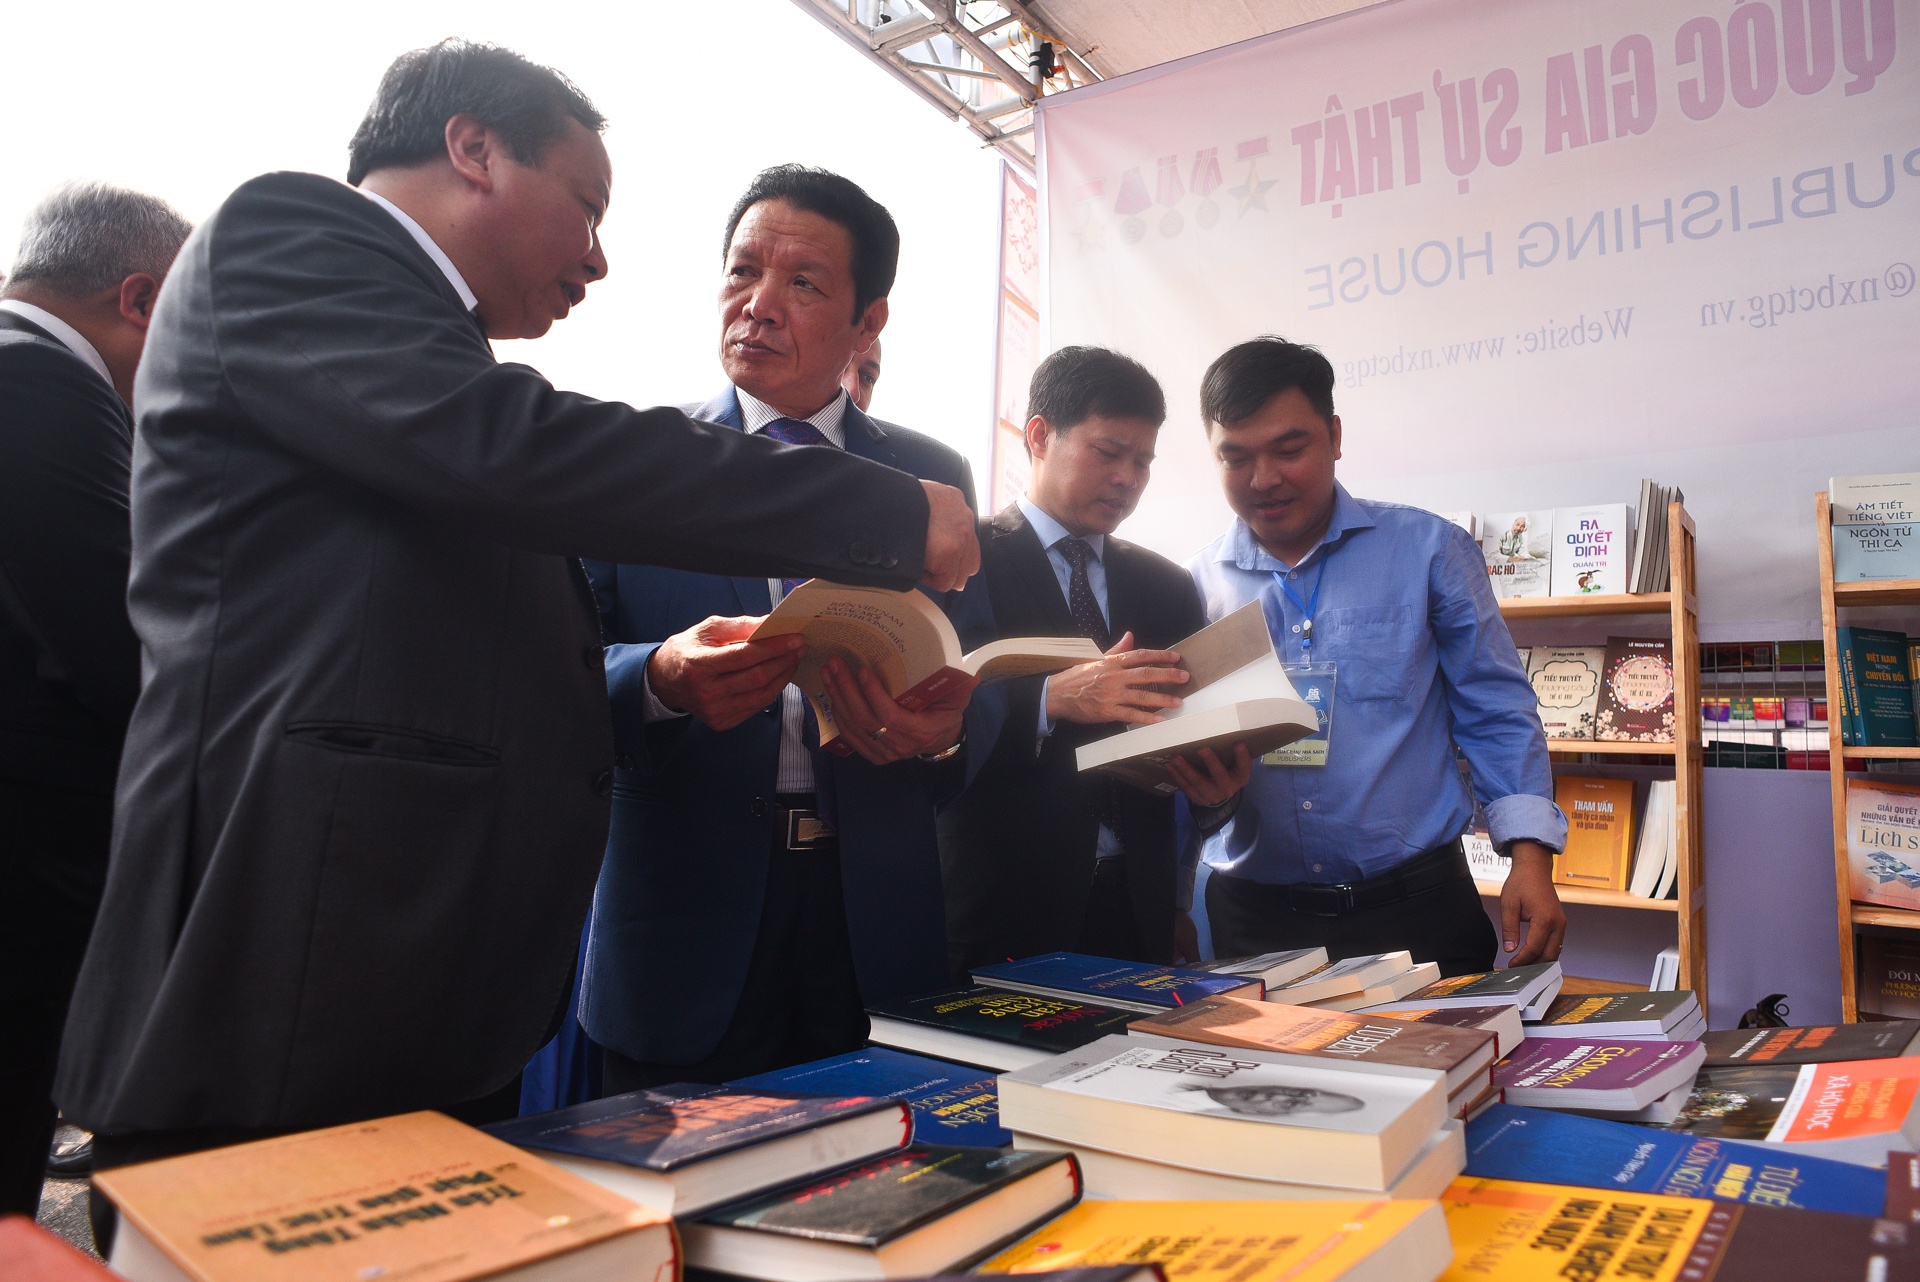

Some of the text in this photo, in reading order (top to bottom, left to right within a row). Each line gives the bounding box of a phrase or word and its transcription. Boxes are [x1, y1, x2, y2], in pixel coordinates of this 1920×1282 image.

[1879, 500, 1904, 510] TIẾT
[1848, 510, 1913, 522] TIẾNG VIỆT
[1580, 519, 1599, 531] RA
[1567, 530, 1612, 545] QUYẾT
[1850, 526, 1912, 538] NGÔN TỪ
[1859, 540, 1902, 548] THI CA
[1575, 545, 1608, 558] ĐỊNH
[1866, 653, 1897, 664] VIỆT NAM
[1574, 800, 1614, 812] THAM VẤN
[1894, 806, 1918, 816] QUYẾT
[1861, 812, 1886, 822] NHỮNG
[1889, 814, 1904, 824] VẤN
[1861, 828, 1902, 848] Lịch
[1544, 1046, 1625, 1088] CHOMSKY
[1826, 1075, 1852, 1090] XÃ
[1814, 1090, 1846, 1108] HỘI
[1805, 1108, 1836, 1130] HỌC
